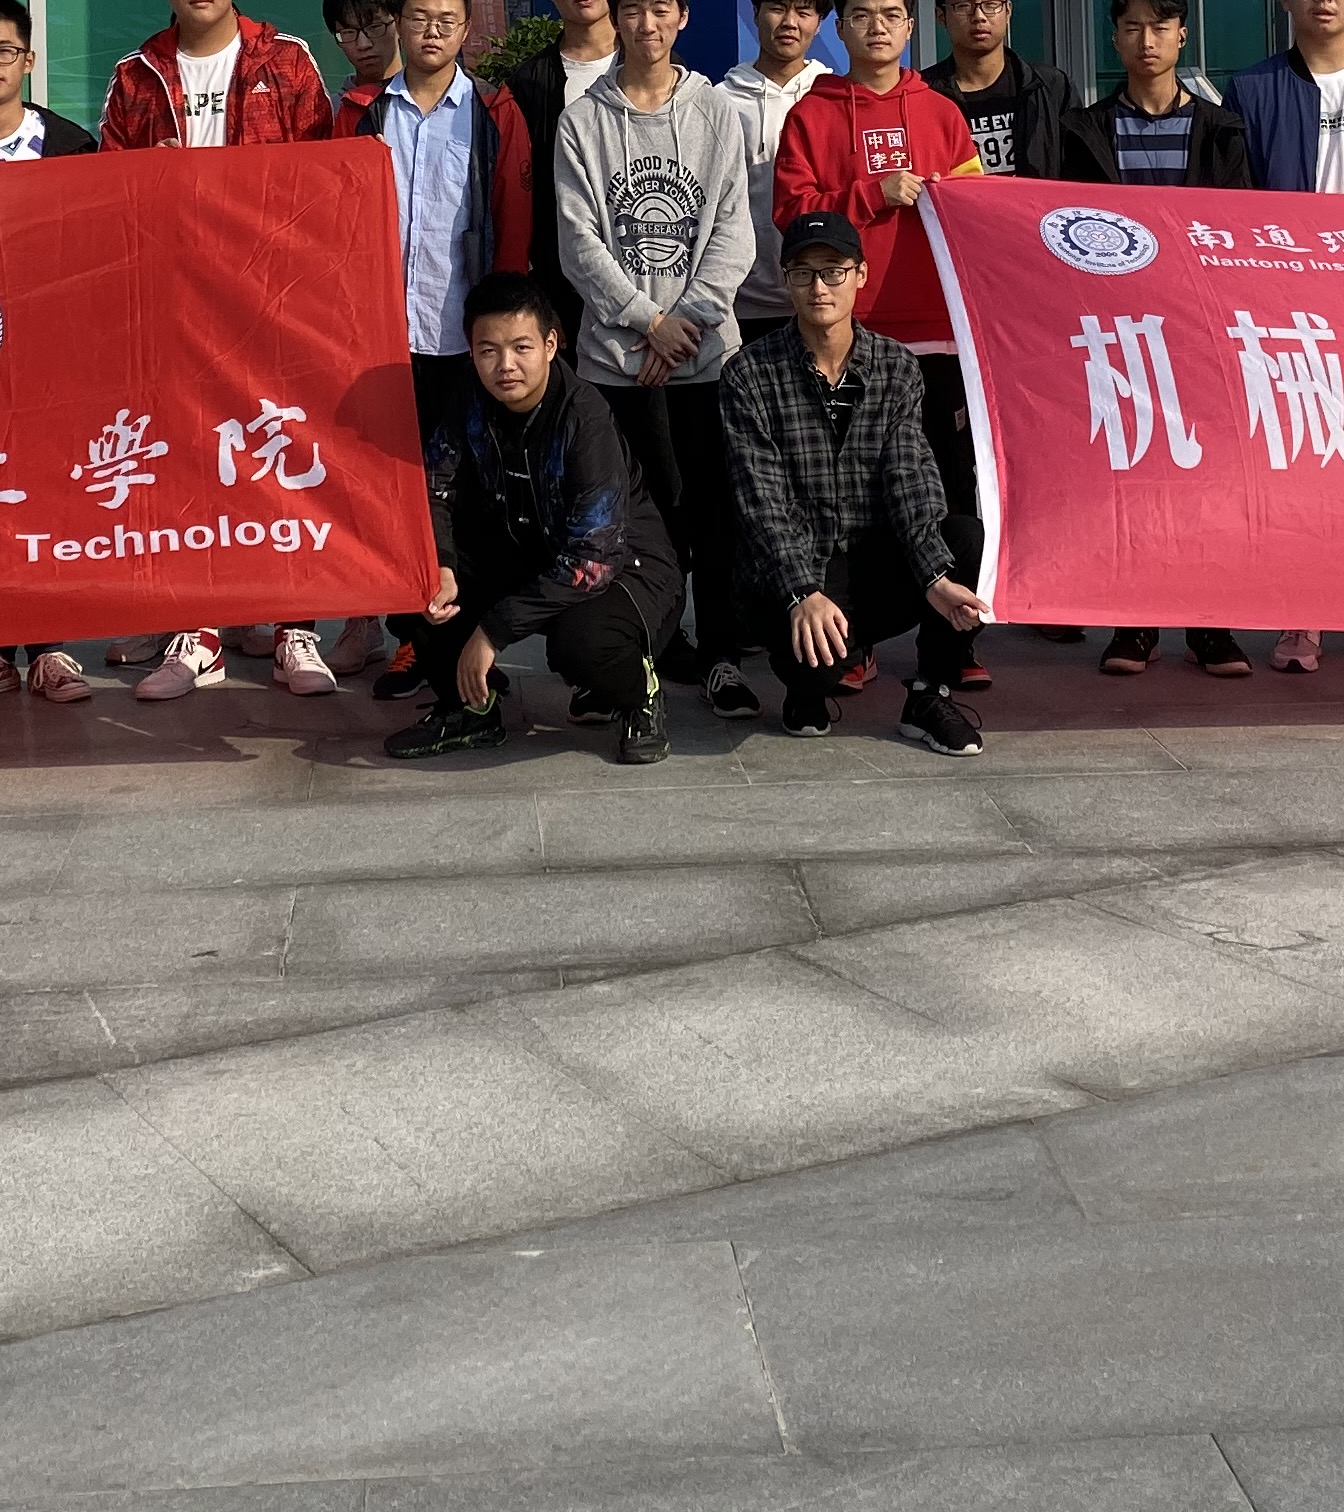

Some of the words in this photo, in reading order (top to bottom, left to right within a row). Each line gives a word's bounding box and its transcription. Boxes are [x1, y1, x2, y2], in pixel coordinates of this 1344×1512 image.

[970, 116, 990, 133] LE
[867, 131, 904, 150] 中国
[869, 150, 907, 169] 李宁
[974, 135, 1016, 168] 92
[605, 171, 627, 206] THE
[629, 156, 662, 177] GOOD
[632, 222, 684, 235] FREE&EASY
[1199, 254, 1304, 272] Nantong
[14, 514, 332, 566] Technology
